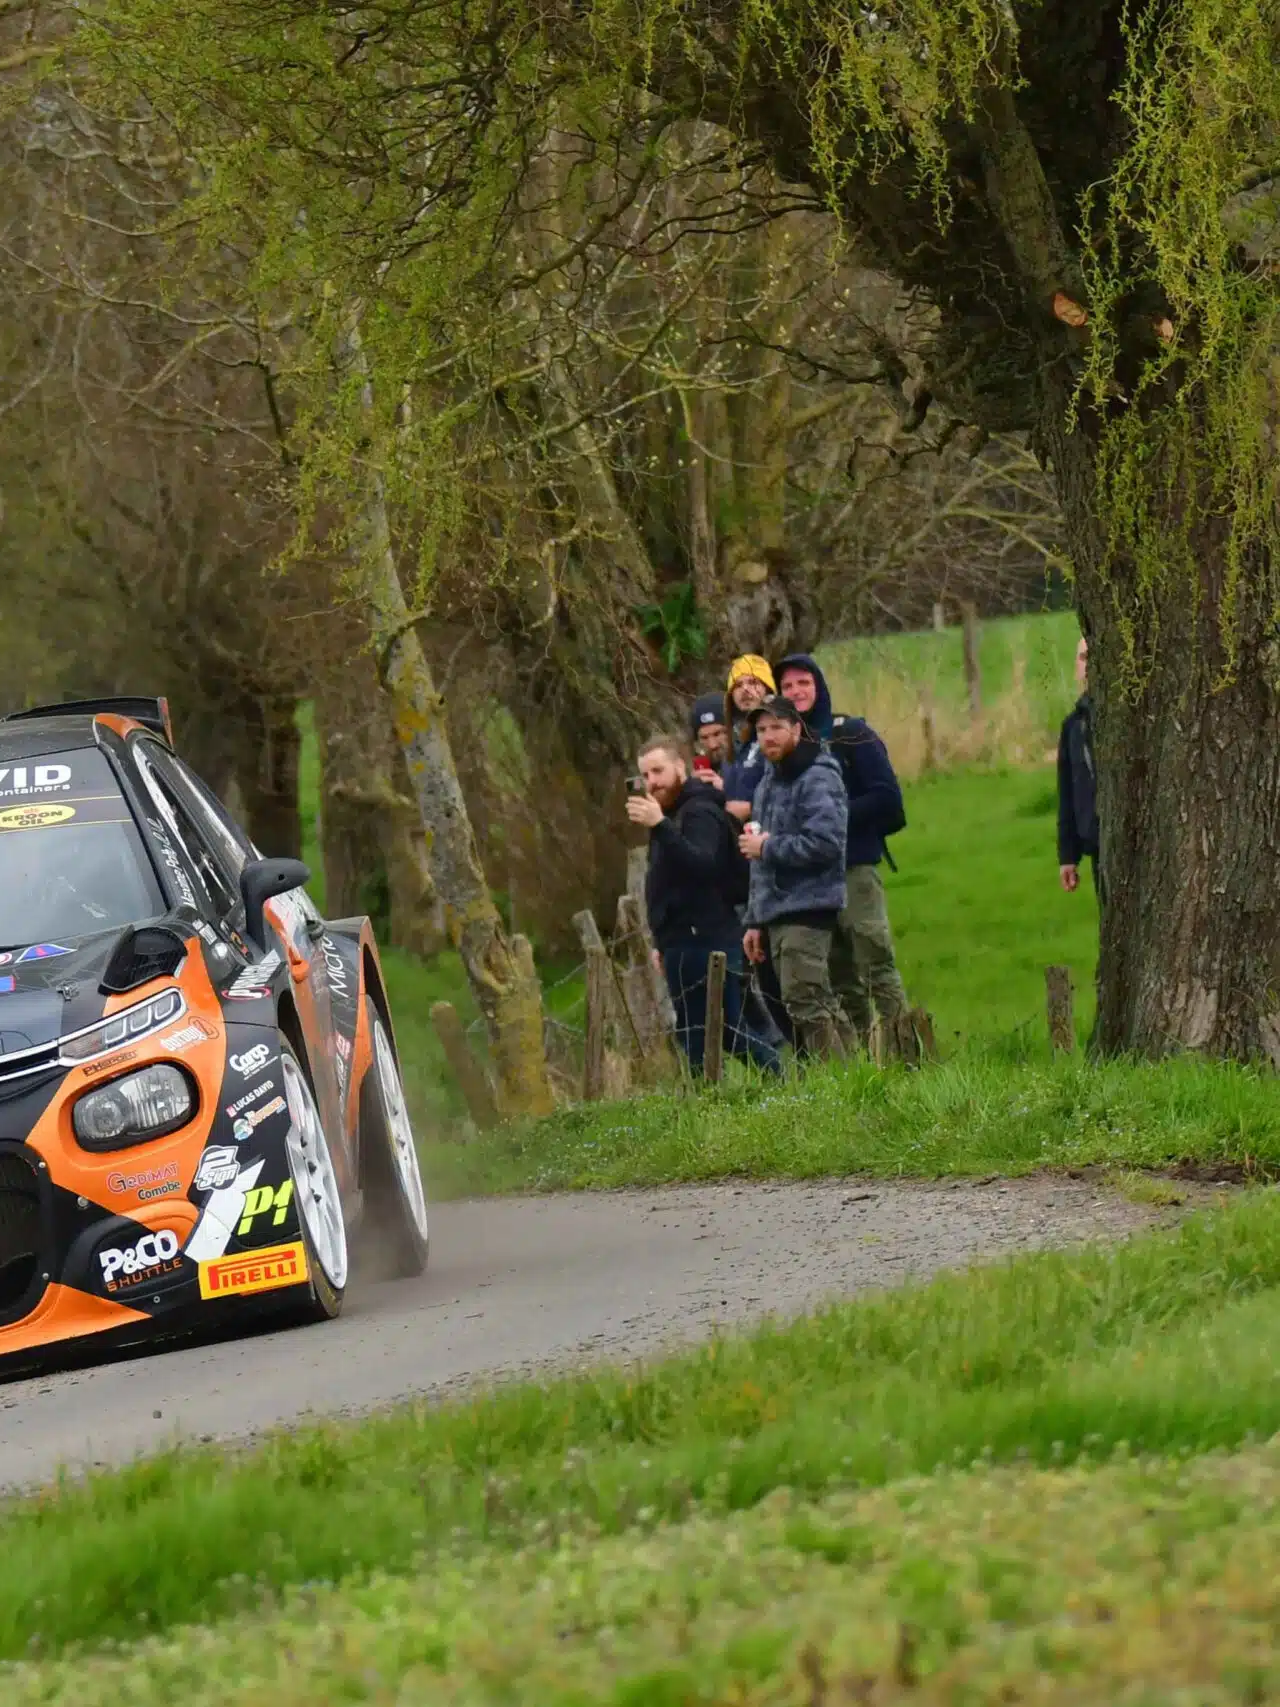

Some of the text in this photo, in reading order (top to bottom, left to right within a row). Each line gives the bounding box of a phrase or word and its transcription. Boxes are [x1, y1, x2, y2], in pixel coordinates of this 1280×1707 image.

[1, 809, 63, 823] KROON
[18, 817, 45, 826] OIL
[229, 1043, 270, 1073] Cargo
[234, 1080, 274, 1111] LUCAS DAVID
[138, 1180, 182, 1201] Comobe
[196, 1166, 239, 1190] Sign
[238, 1178, 293, 1236] P1
[100, 1229, 179, 1283] P&CO
[207, 1249, 297, 1291] PIRELLI
[106, 1258, 183, 1293] SHUTTLE
